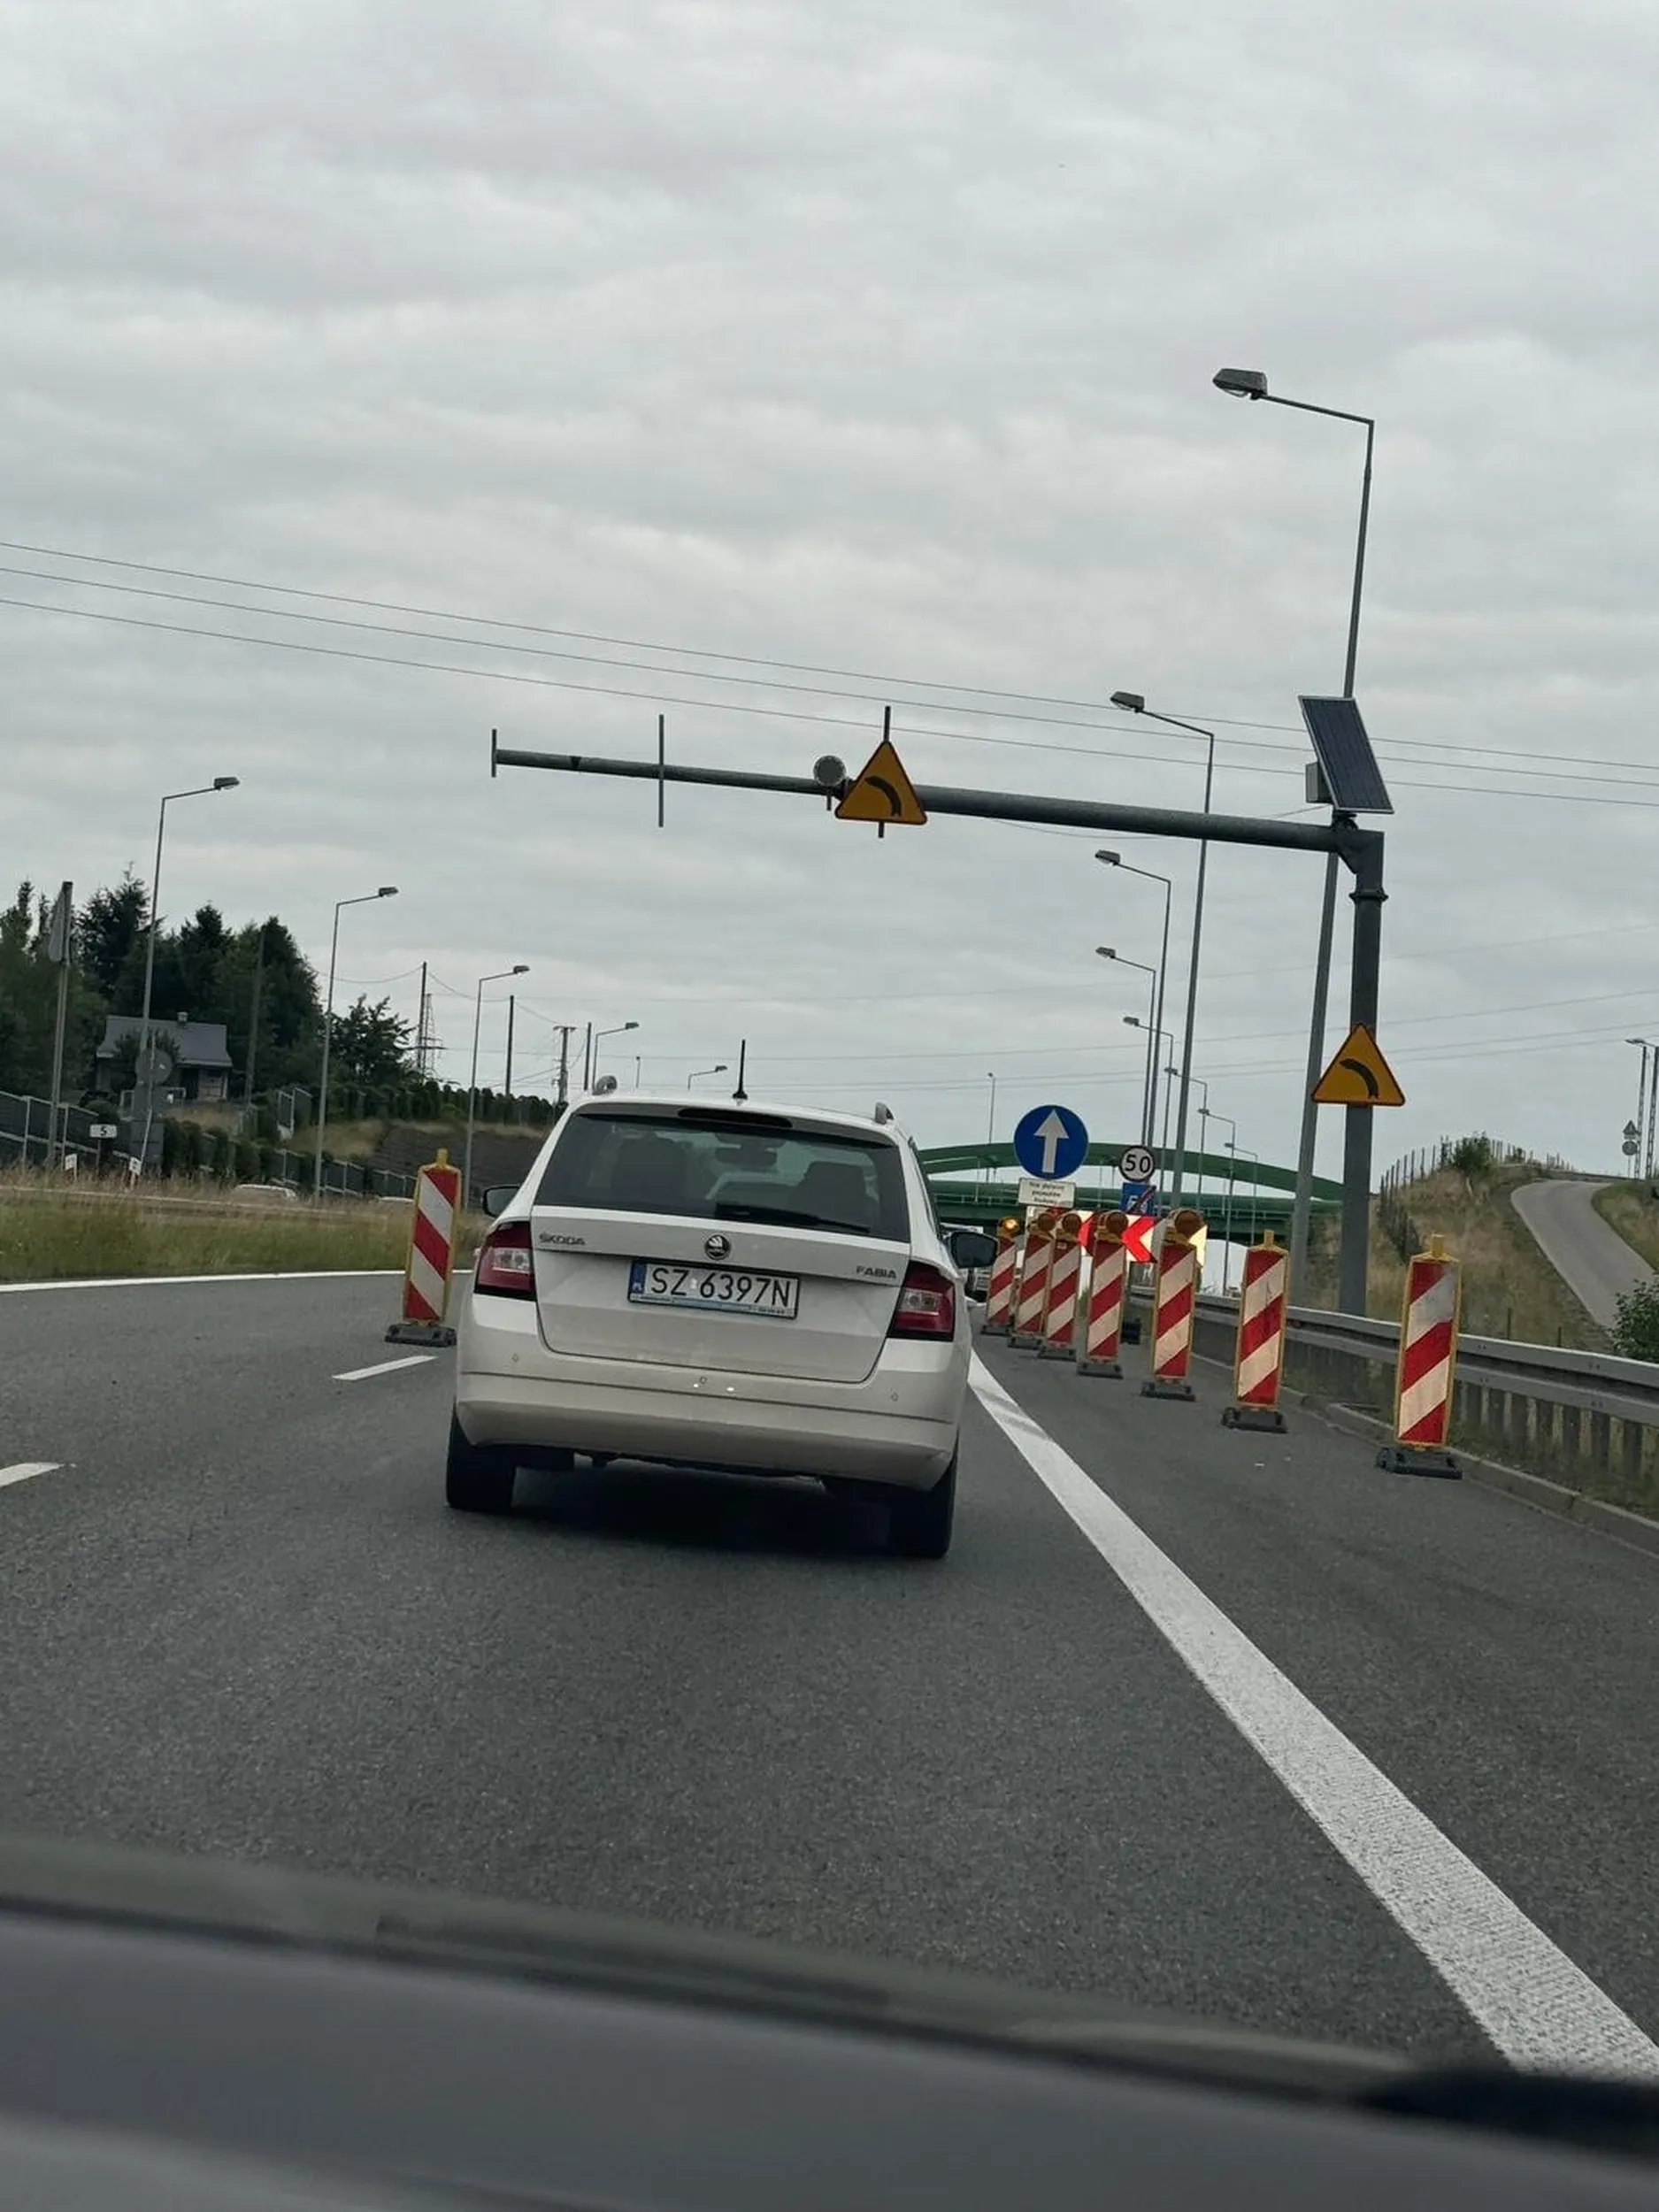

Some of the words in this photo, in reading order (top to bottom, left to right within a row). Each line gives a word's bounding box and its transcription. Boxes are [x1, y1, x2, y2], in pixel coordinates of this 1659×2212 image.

[1125, 1154, 1151, 1173] 50
[856, 1265, 896, 1279] FABIA
[650, 1267, 690, 1296] SZ
[700, 1272, 790, 1308] 6397N
